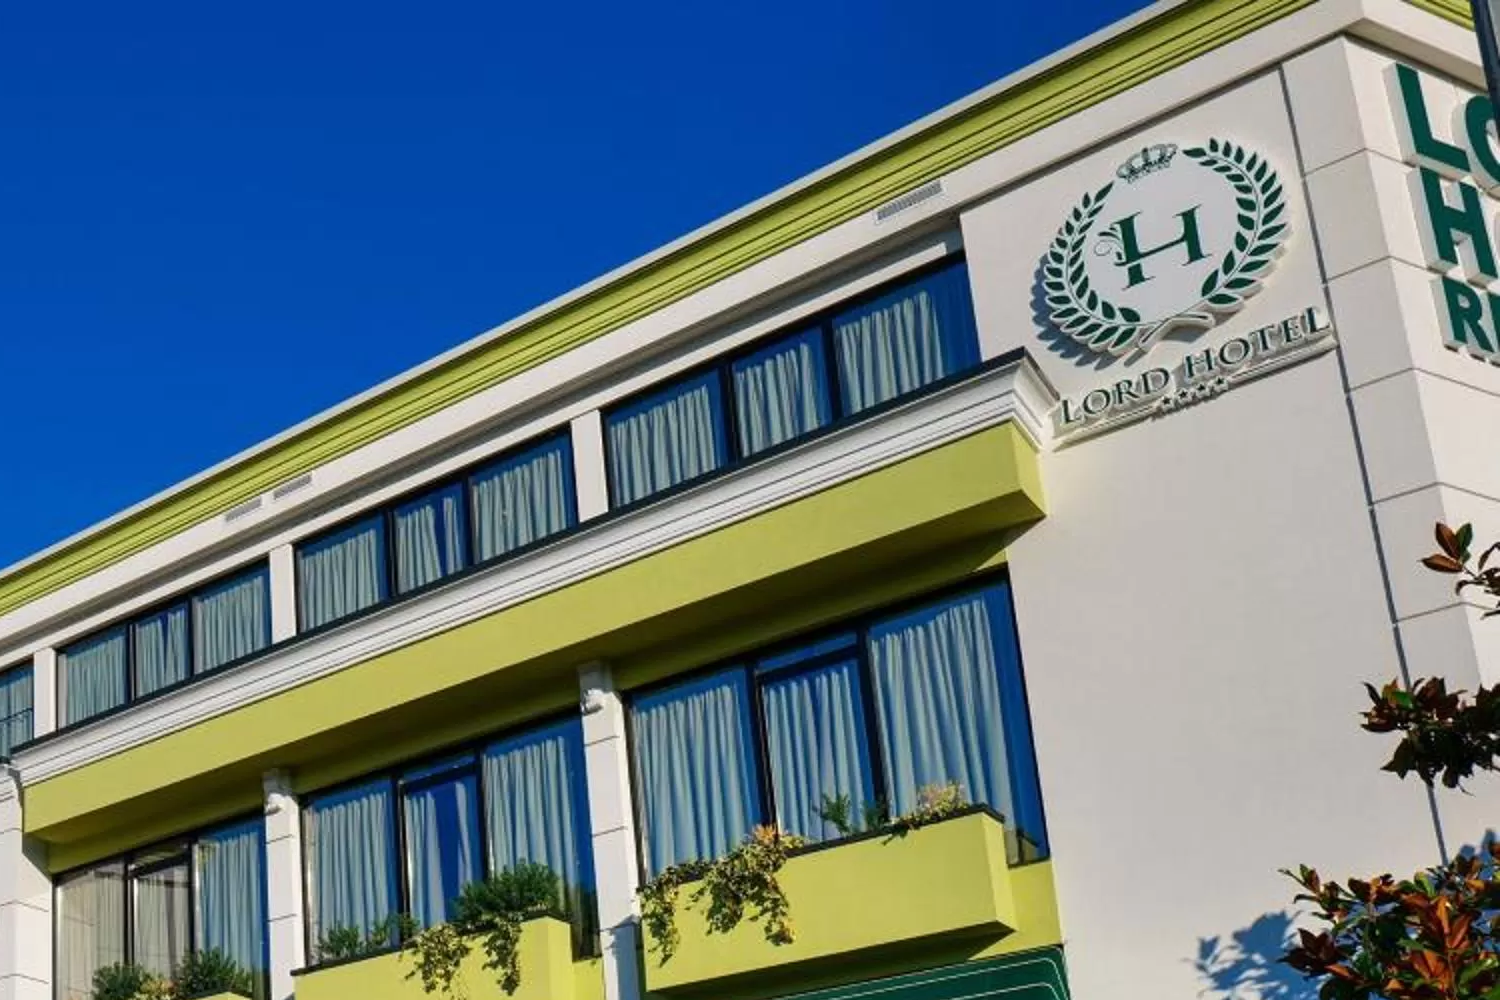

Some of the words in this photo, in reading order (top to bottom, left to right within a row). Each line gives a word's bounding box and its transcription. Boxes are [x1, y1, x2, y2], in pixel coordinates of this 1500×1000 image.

[1442, 275, 1500, 353] R
[1060, 366, 1171, 425] LORD
[1184, 305, 1331, 379] HOTEL
